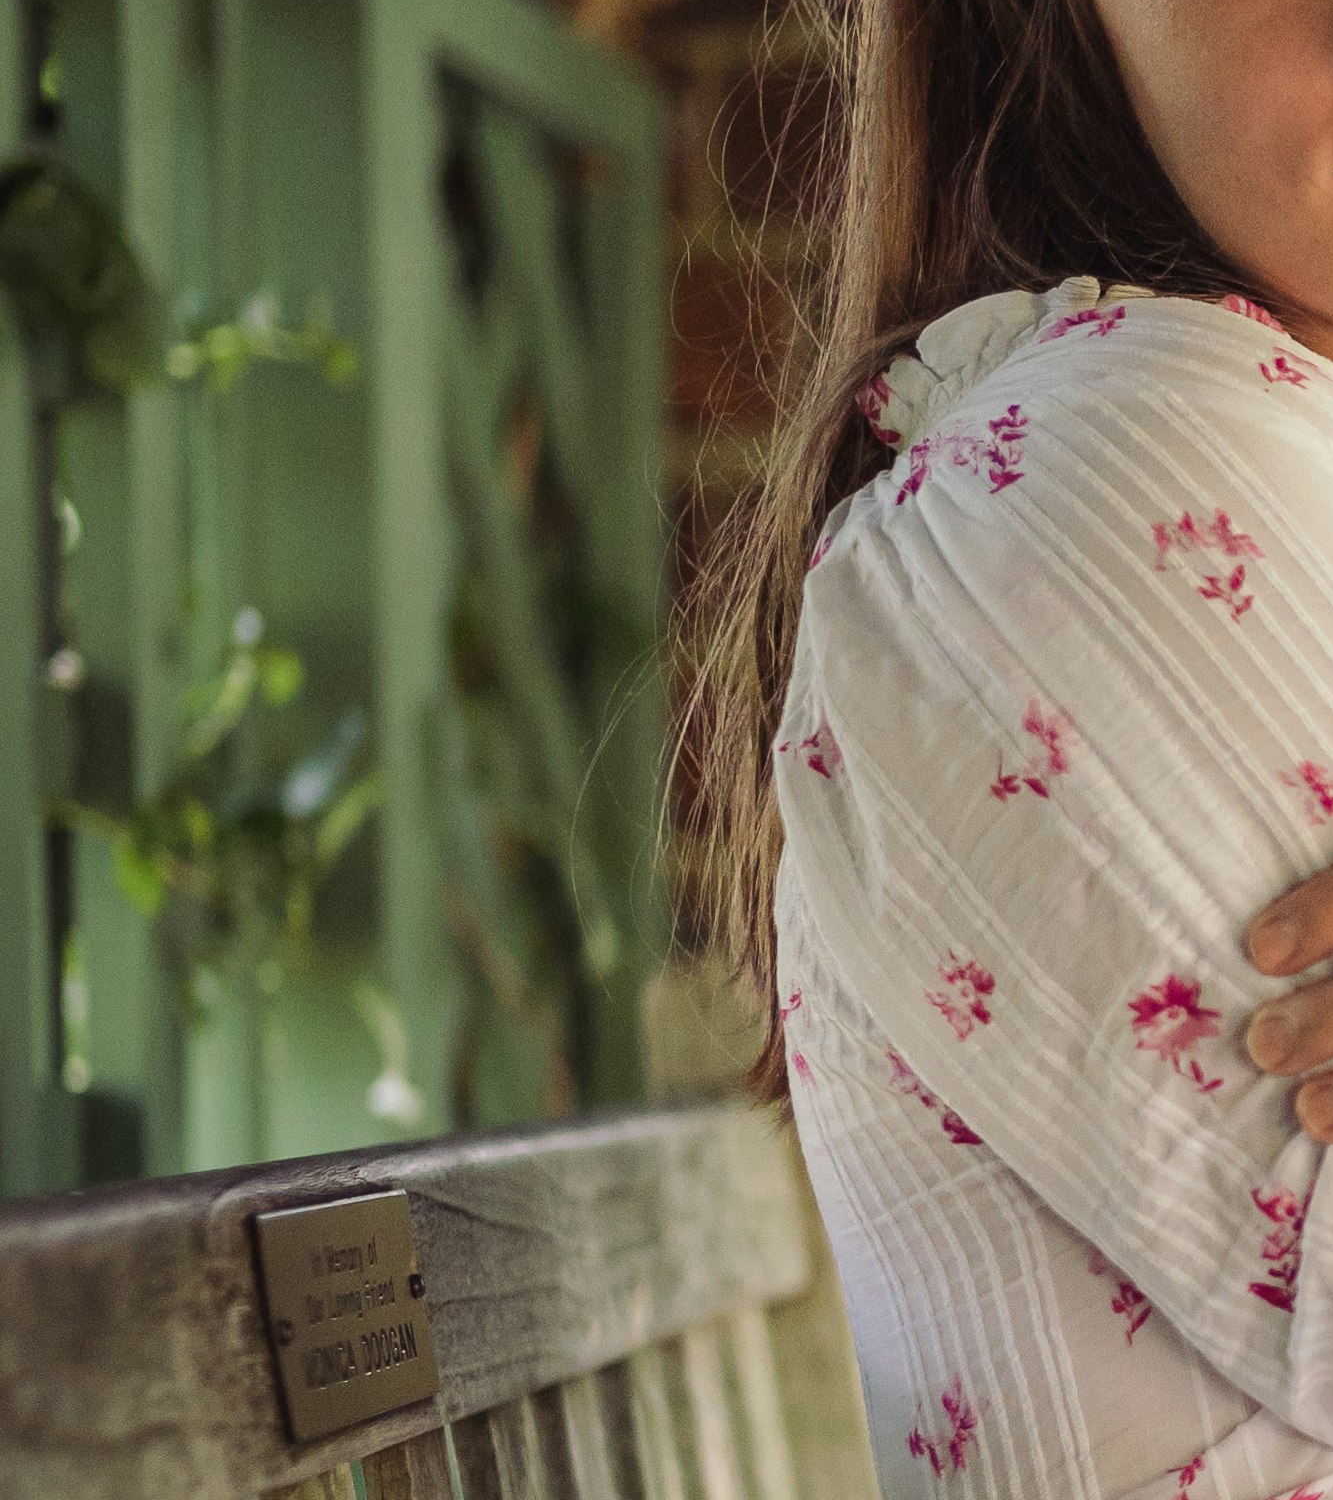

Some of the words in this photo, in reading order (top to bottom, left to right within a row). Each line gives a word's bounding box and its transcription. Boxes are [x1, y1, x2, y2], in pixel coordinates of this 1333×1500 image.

[323, 1245, 364, 1274] Memory
[367, 1233, 378, 1268] of
[328, 1289, 364, 1320] Loving
[364, 1275, 396, 1311] Friend
[359, 1318, 418, 1376] DOOGAN
